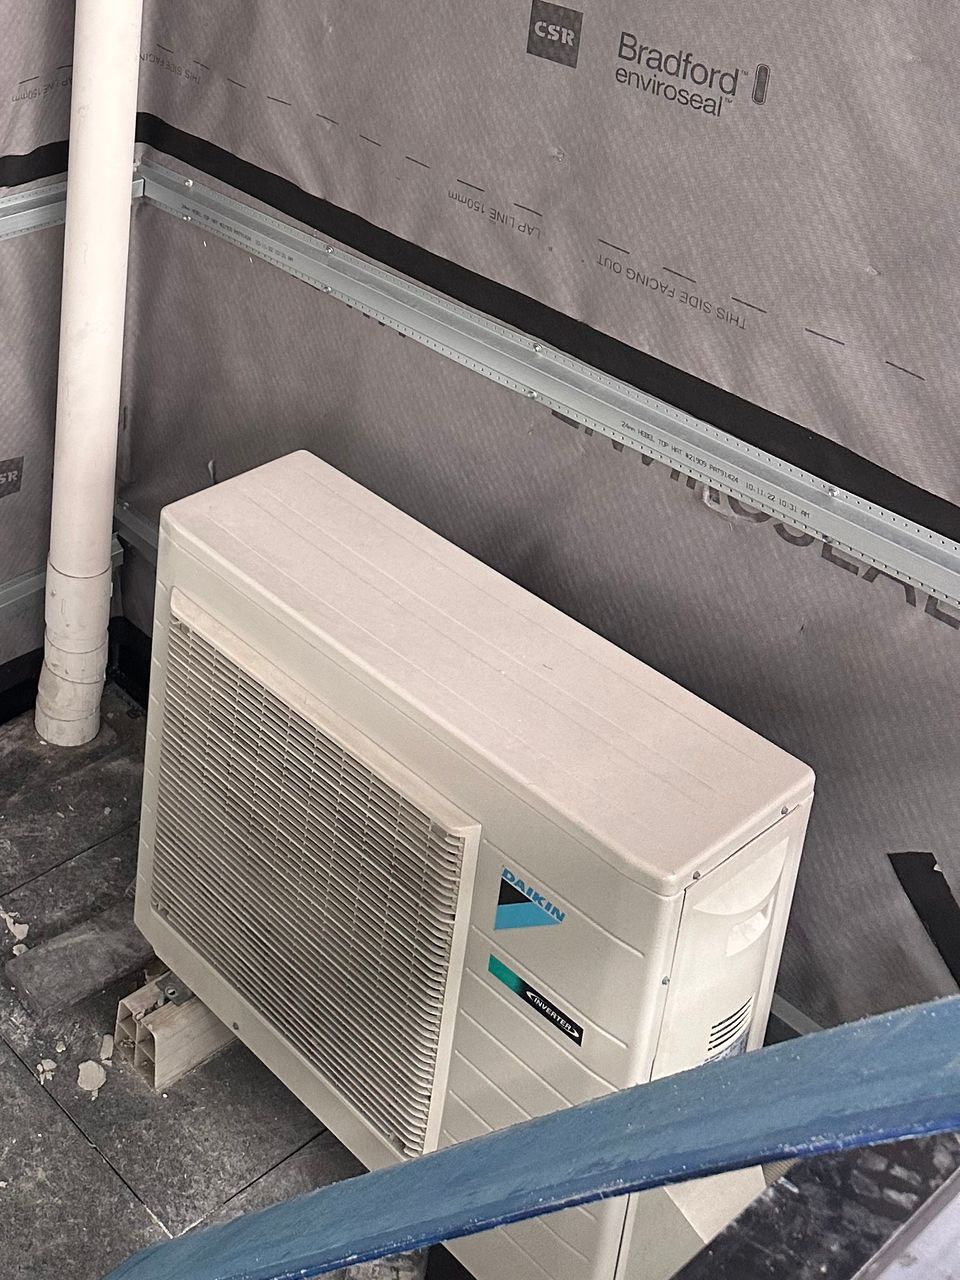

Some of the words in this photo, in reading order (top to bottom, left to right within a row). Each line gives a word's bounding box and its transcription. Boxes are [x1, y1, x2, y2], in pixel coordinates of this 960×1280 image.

[533, 21, 576, 47] CSR
[448, 190, 486, 214] 150mm
[489, 207, 516, 229] LINE
[517, 223, 541, 239] LAP
[596, 253, 623, 275] OUT
[626, 267, 676, 298] FACING
[679, 291, 713, 315] SIDE
[715, 305, 747, 331] THIS
[657, 438, 669, 448] TOP
[501, 867, 566, 922] DAIKIN
[533, 995, 573, 1033] INVERTER
